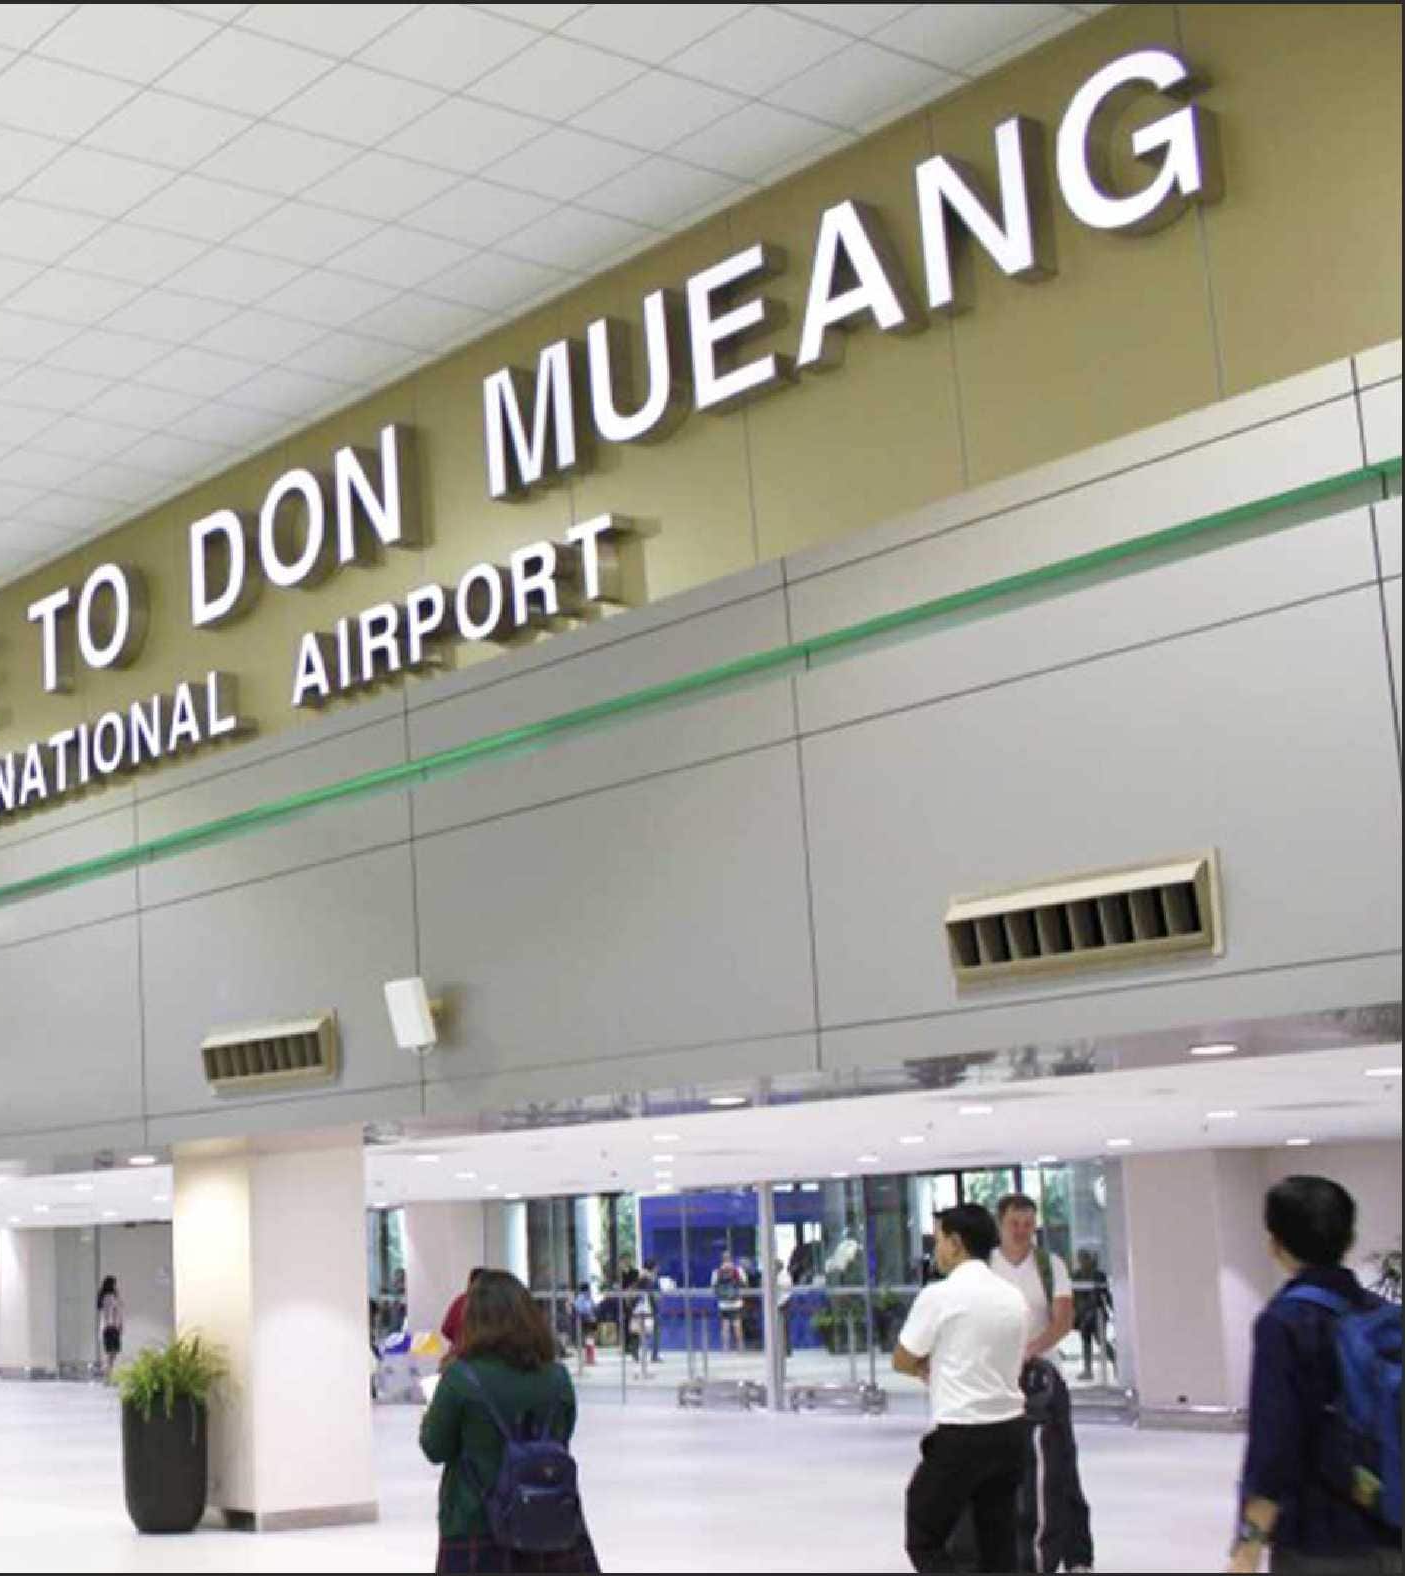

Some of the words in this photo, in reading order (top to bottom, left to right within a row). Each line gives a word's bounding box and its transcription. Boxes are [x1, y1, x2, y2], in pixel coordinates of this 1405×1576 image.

[26, 563, 131, 692] TO
[187, 423, 404, 628] DON
[483, 48, 1203, 500] MUEANG
[291, 512, 619, 706] AIRPORT
